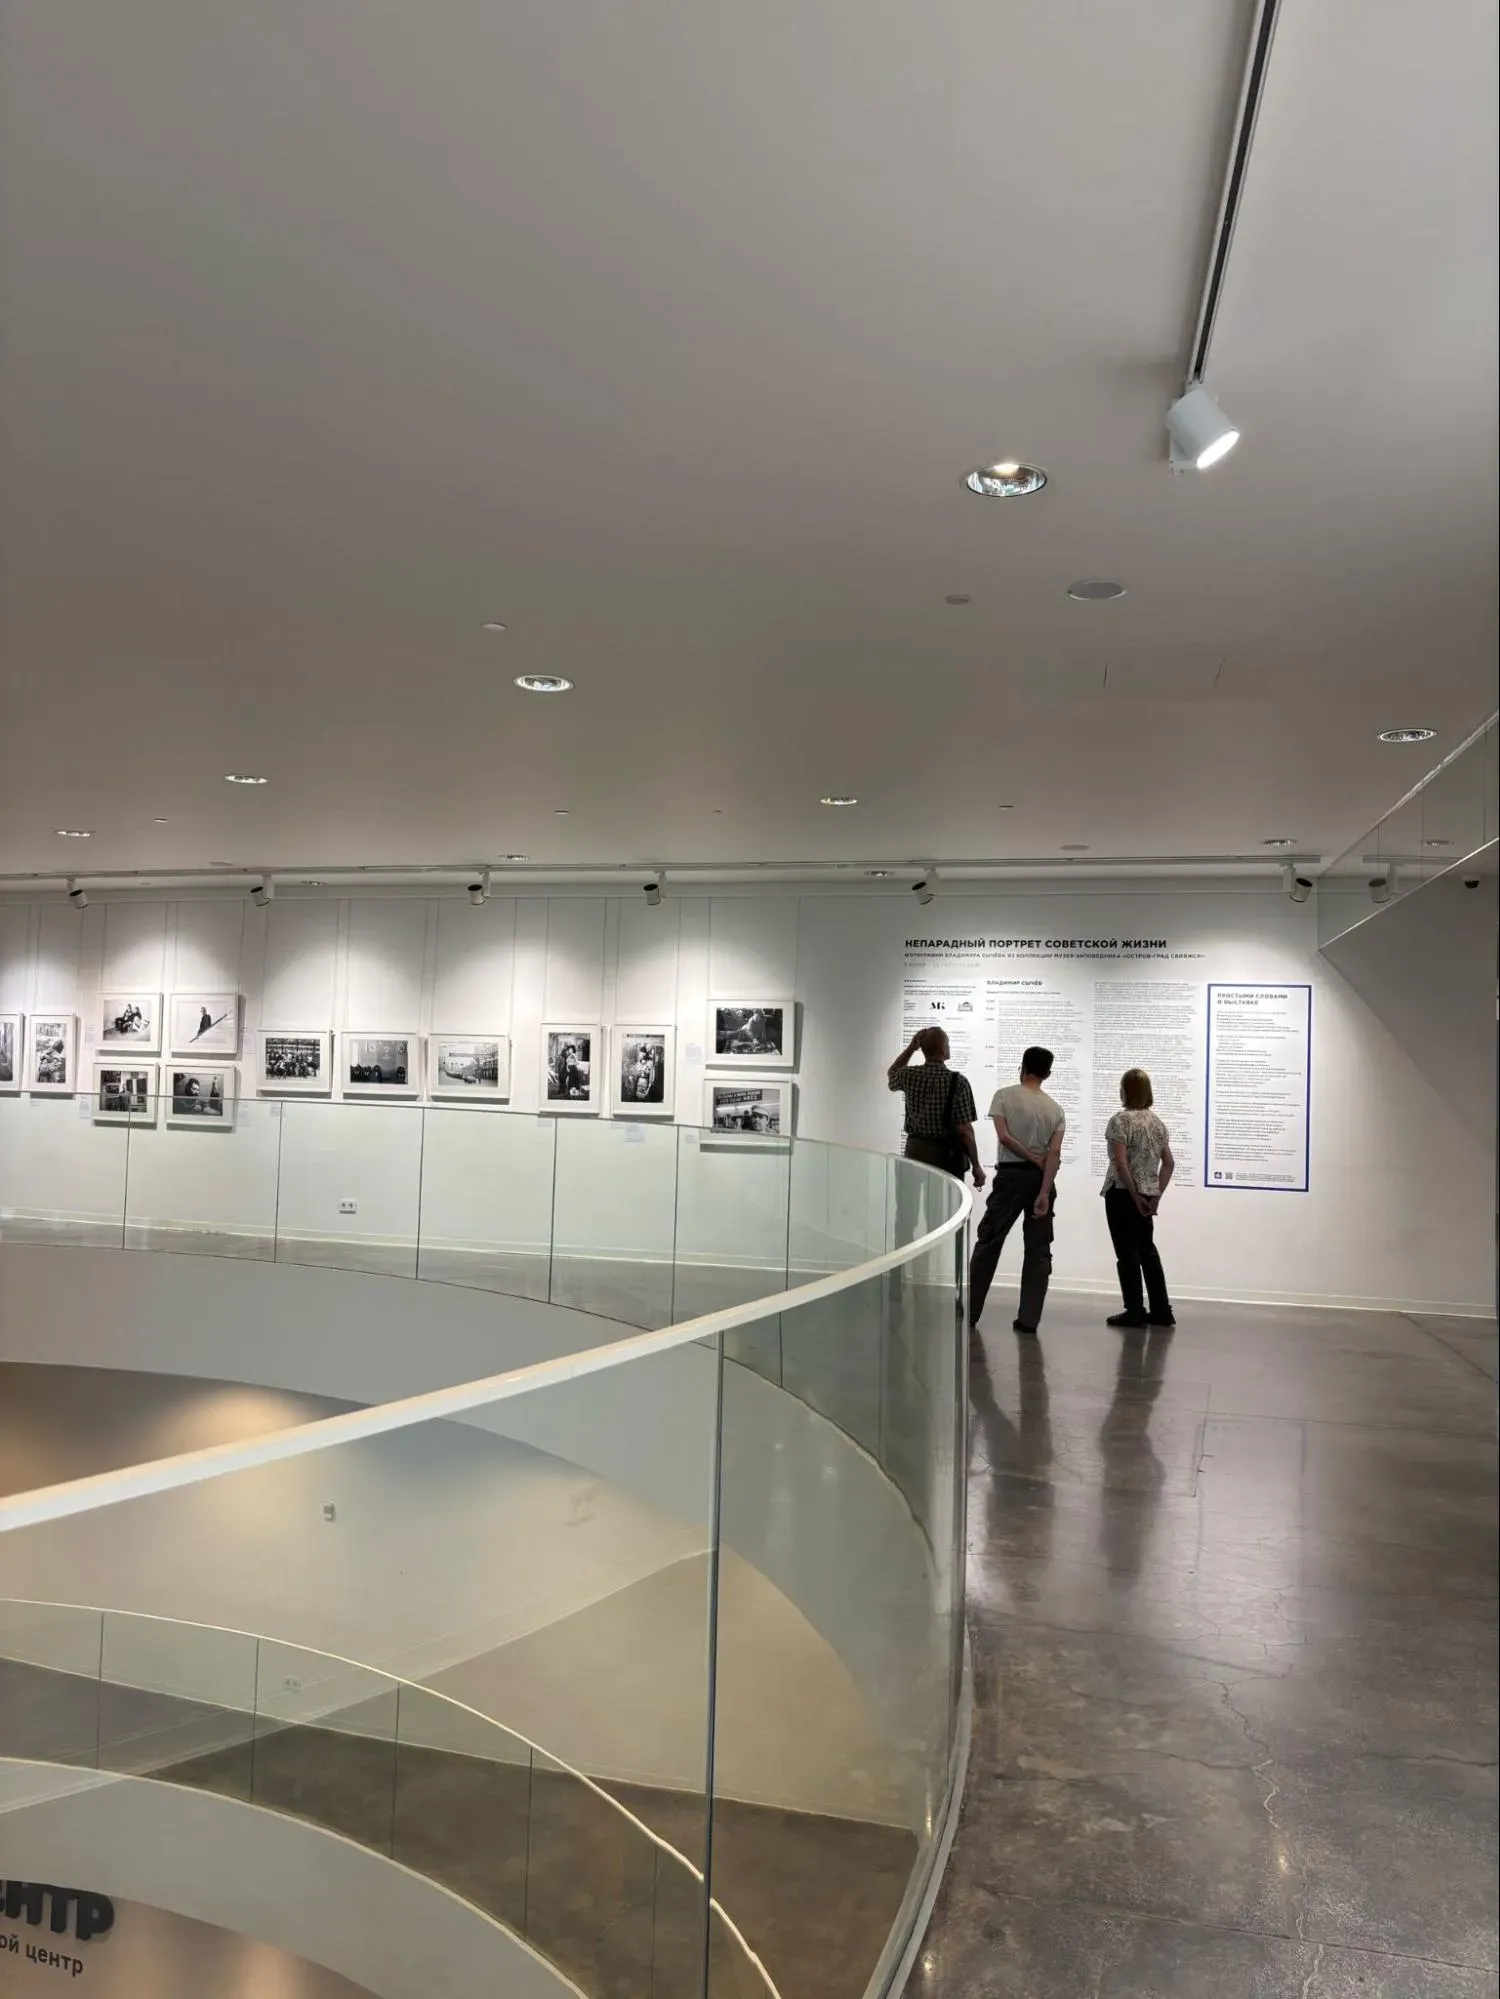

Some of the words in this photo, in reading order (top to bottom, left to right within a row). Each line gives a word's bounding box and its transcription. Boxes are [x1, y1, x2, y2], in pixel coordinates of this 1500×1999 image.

[905, 938, 986, 949] НЕПАРАДНЫЙ
[989, 939, 1042, 949] ПОРТРЕТ
[1045, 938, 1118, 949] СОВЕТСКОЙ
[1121, 940, 1167, 949] ЖИЗНИ
[0, 1880, 114, 1941] НТР
[26, 1943, 84, 1978] центр
